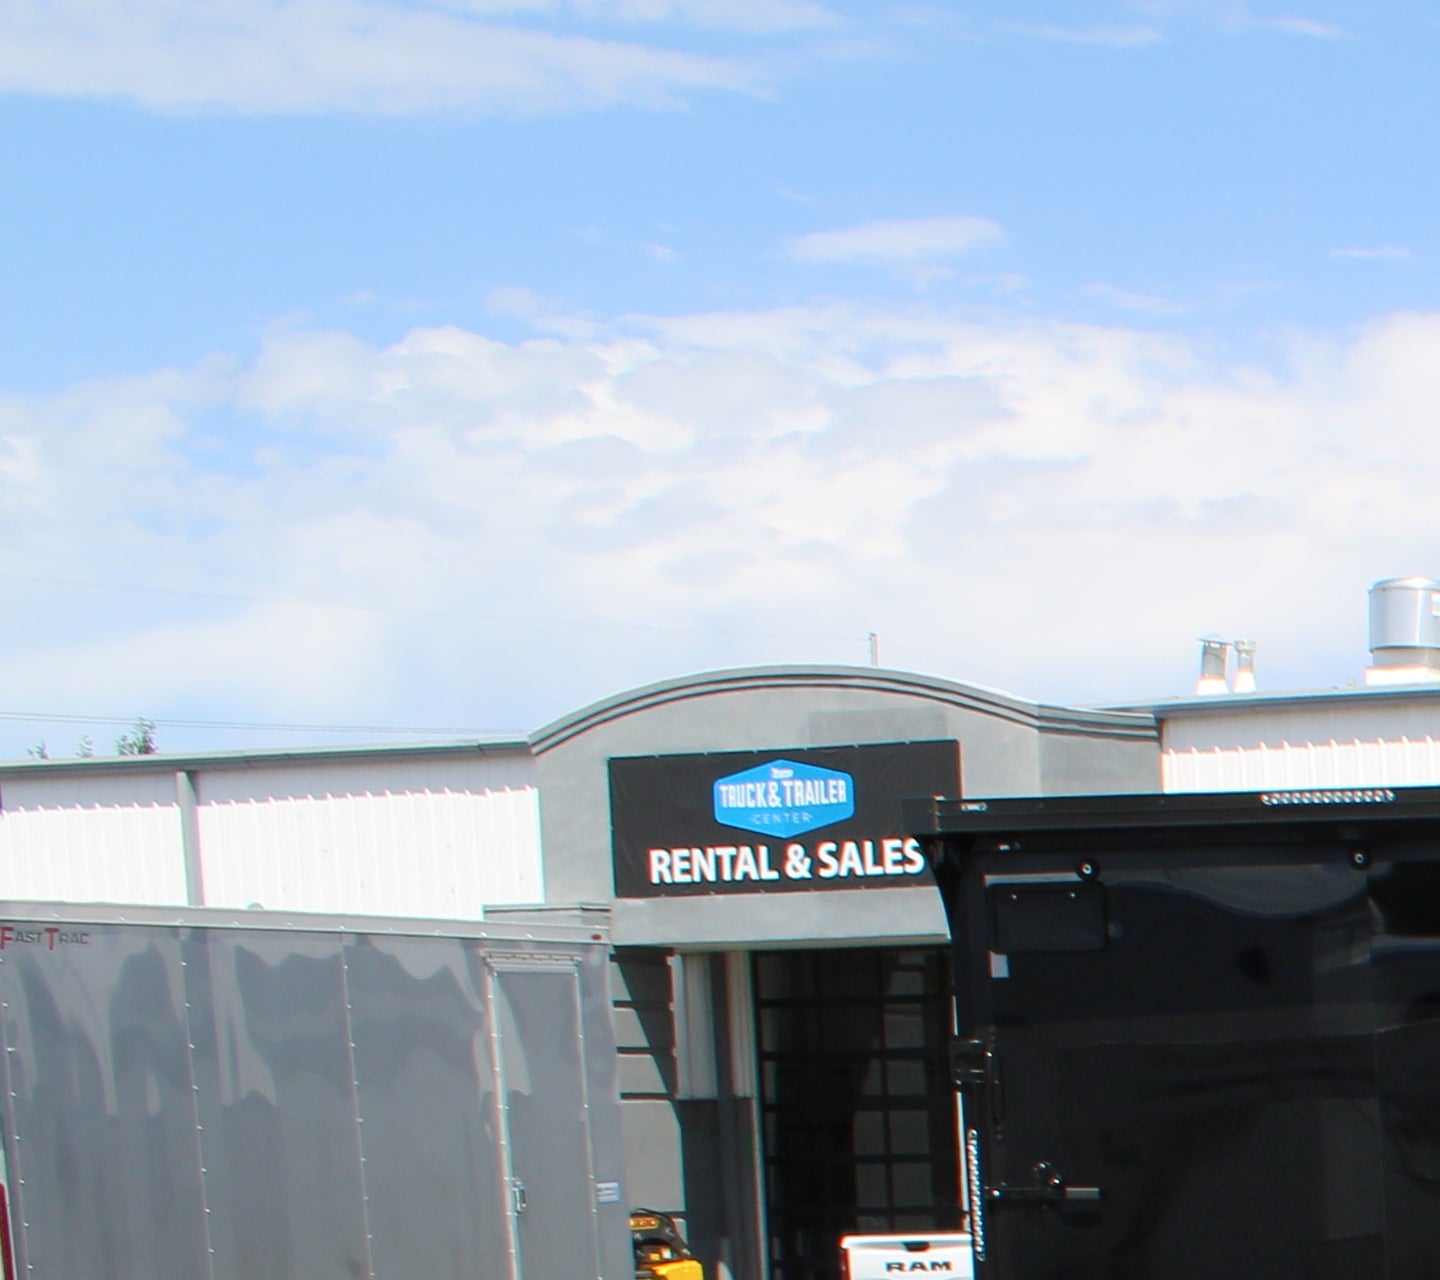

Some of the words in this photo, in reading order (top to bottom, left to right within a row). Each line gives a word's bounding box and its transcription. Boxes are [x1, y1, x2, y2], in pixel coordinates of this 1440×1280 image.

[718, 780, 767, 809] TRUCK
[782, 779, 848, 807] TRAILER
[752, 811, 812, 826] CENTER
[648, 844, 780, 885] RENTAL
[784, 841, 812, 880] &
[817, 836, 926, 879] SALES
[885, 1261, 952, 1272] RAM
